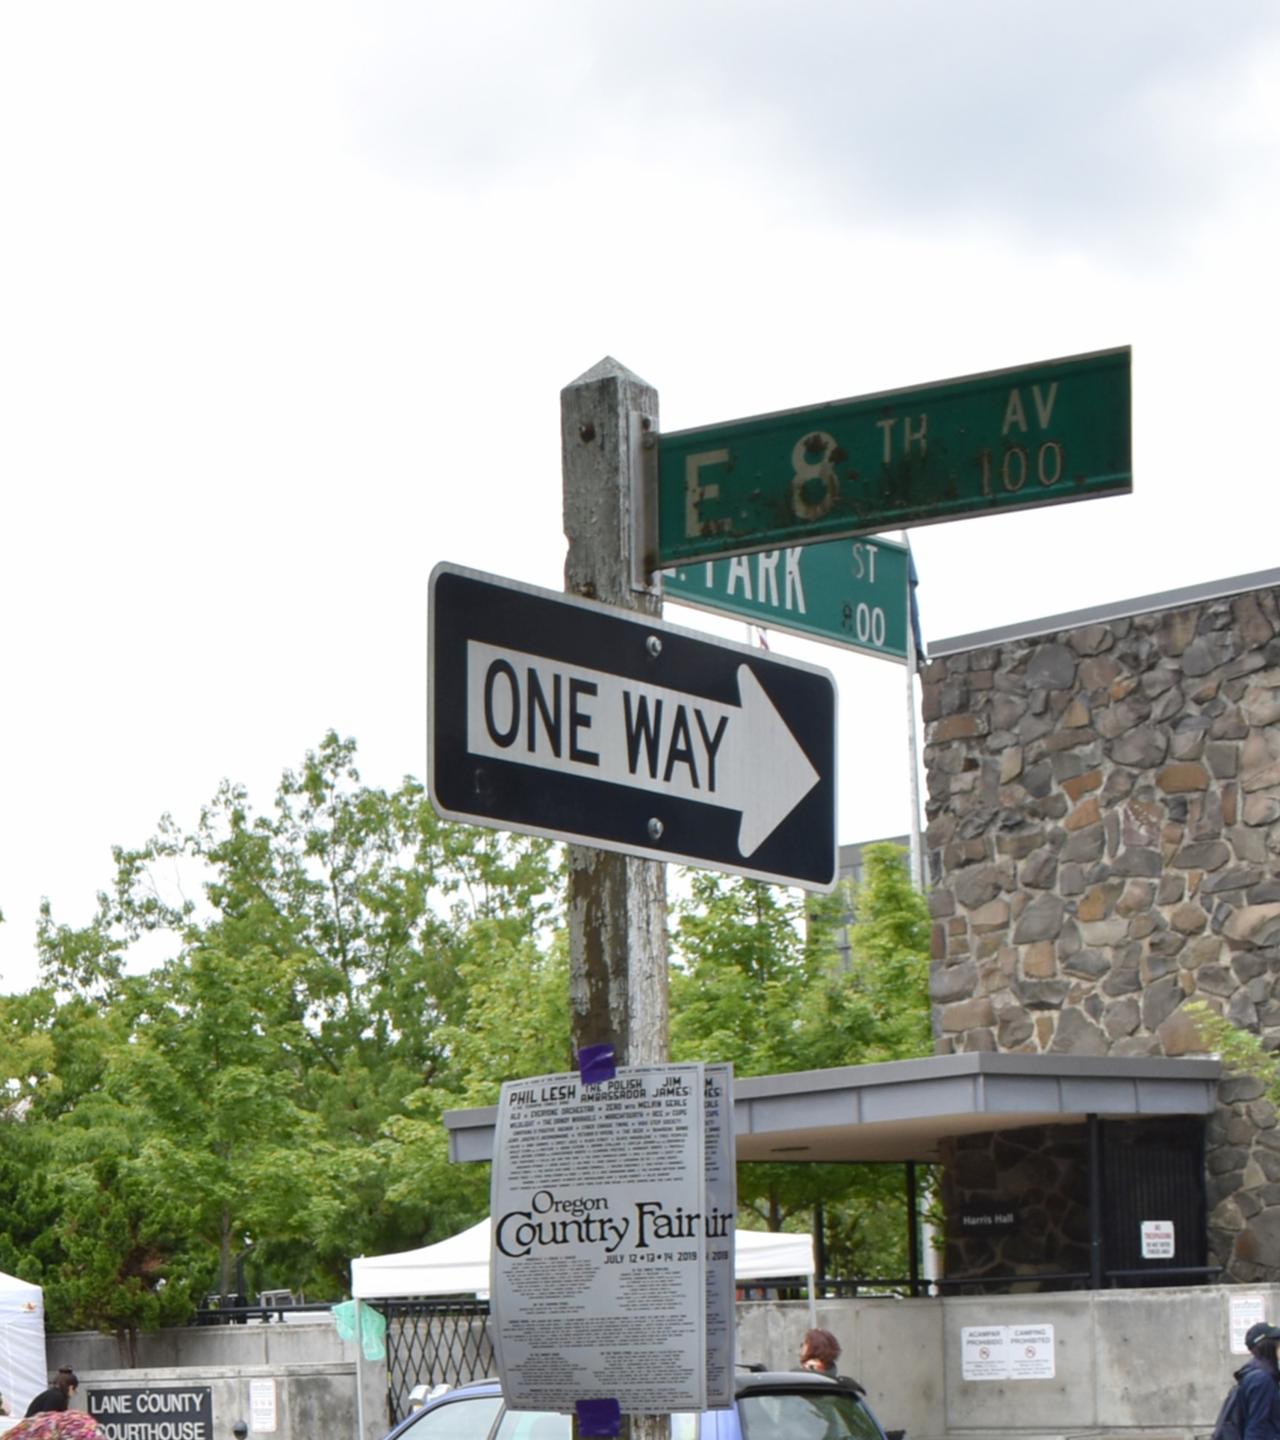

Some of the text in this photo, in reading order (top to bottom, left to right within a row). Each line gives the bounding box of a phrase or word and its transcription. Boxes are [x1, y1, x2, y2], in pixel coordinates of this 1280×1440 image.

[685, 382, 1059, 540] E 8 TH AV
[981, 442, 1064, 497] 100
[852, 544, 878, 583] ST
[483, 658, 730, 796] ONE WAY
[608, 1078, 642, 1091] POLISH
[652, 1086, 689, 1098] JAMES
[662, 1076, 682, 1088] JIM
[509, 1090, 538, 1106] PHIL
[541, 1084, 576, 1102] LESH
[532, 1190, 609, 1217] Oregon
[963, 1212, 1014, 1225] Harris Hall
[496, 1202, 702, 1258] Country Fair
[604, 1254, 624, 1265] JULY
[91, 1393, 203, 1414] LANE COUNTY
